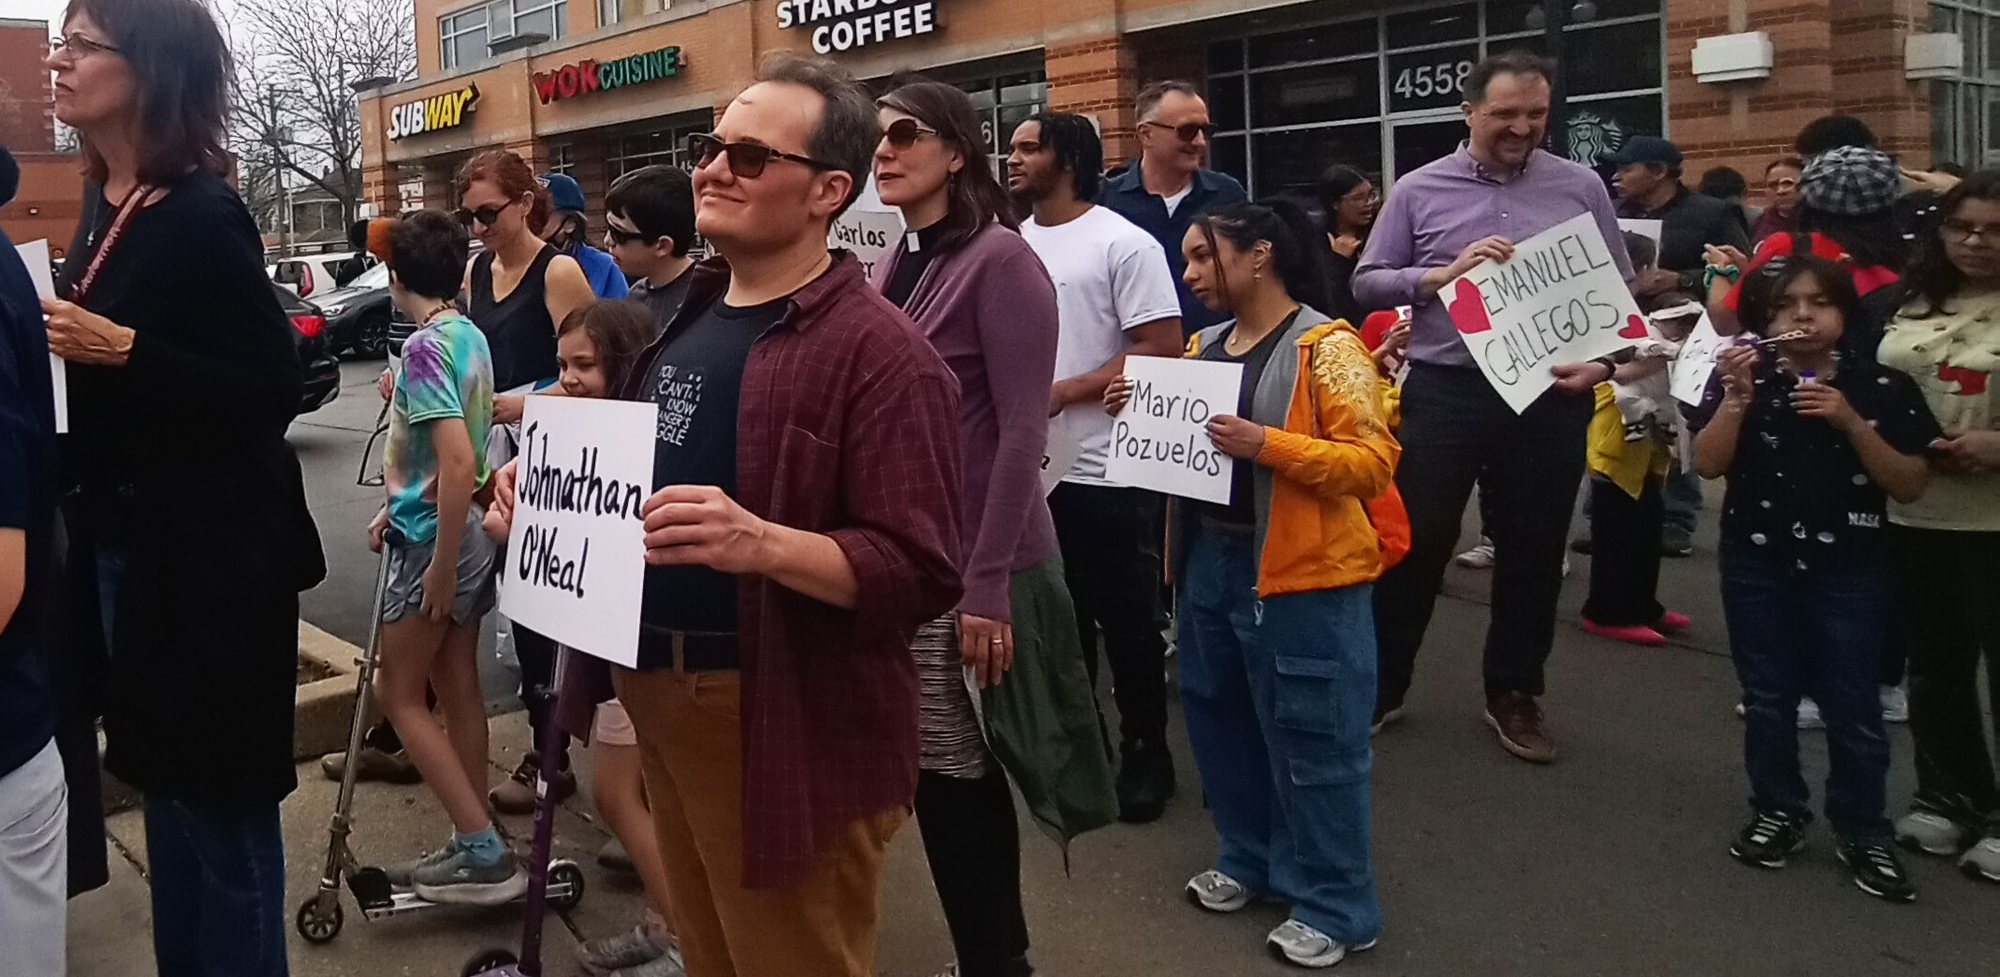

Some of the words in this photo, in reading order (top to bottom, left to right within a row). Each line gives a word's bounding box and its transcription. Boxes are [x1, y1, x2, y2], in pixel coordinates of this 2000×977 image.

[811, 2, 933, 54] COFFEE
[533, 58, 600, 105] WOK
[599, 47, 679, 91] CUISINE
[385, 84, 474, 140] SUBWAY
[833, 219, 886, 248] Carlos
[1477, 234, 1610, 317] EMANUEL
[1484, 290, 1619, 386] GALLEGOS
[1132, 379, 1209, 424] Mario
[656, 423, 687, 446] GGLE
[1115, 420, 1222, 477] Pozuelos
[519, 420, 646, 521] Johnathan
[519, 523, 589, 599] O'Neal
